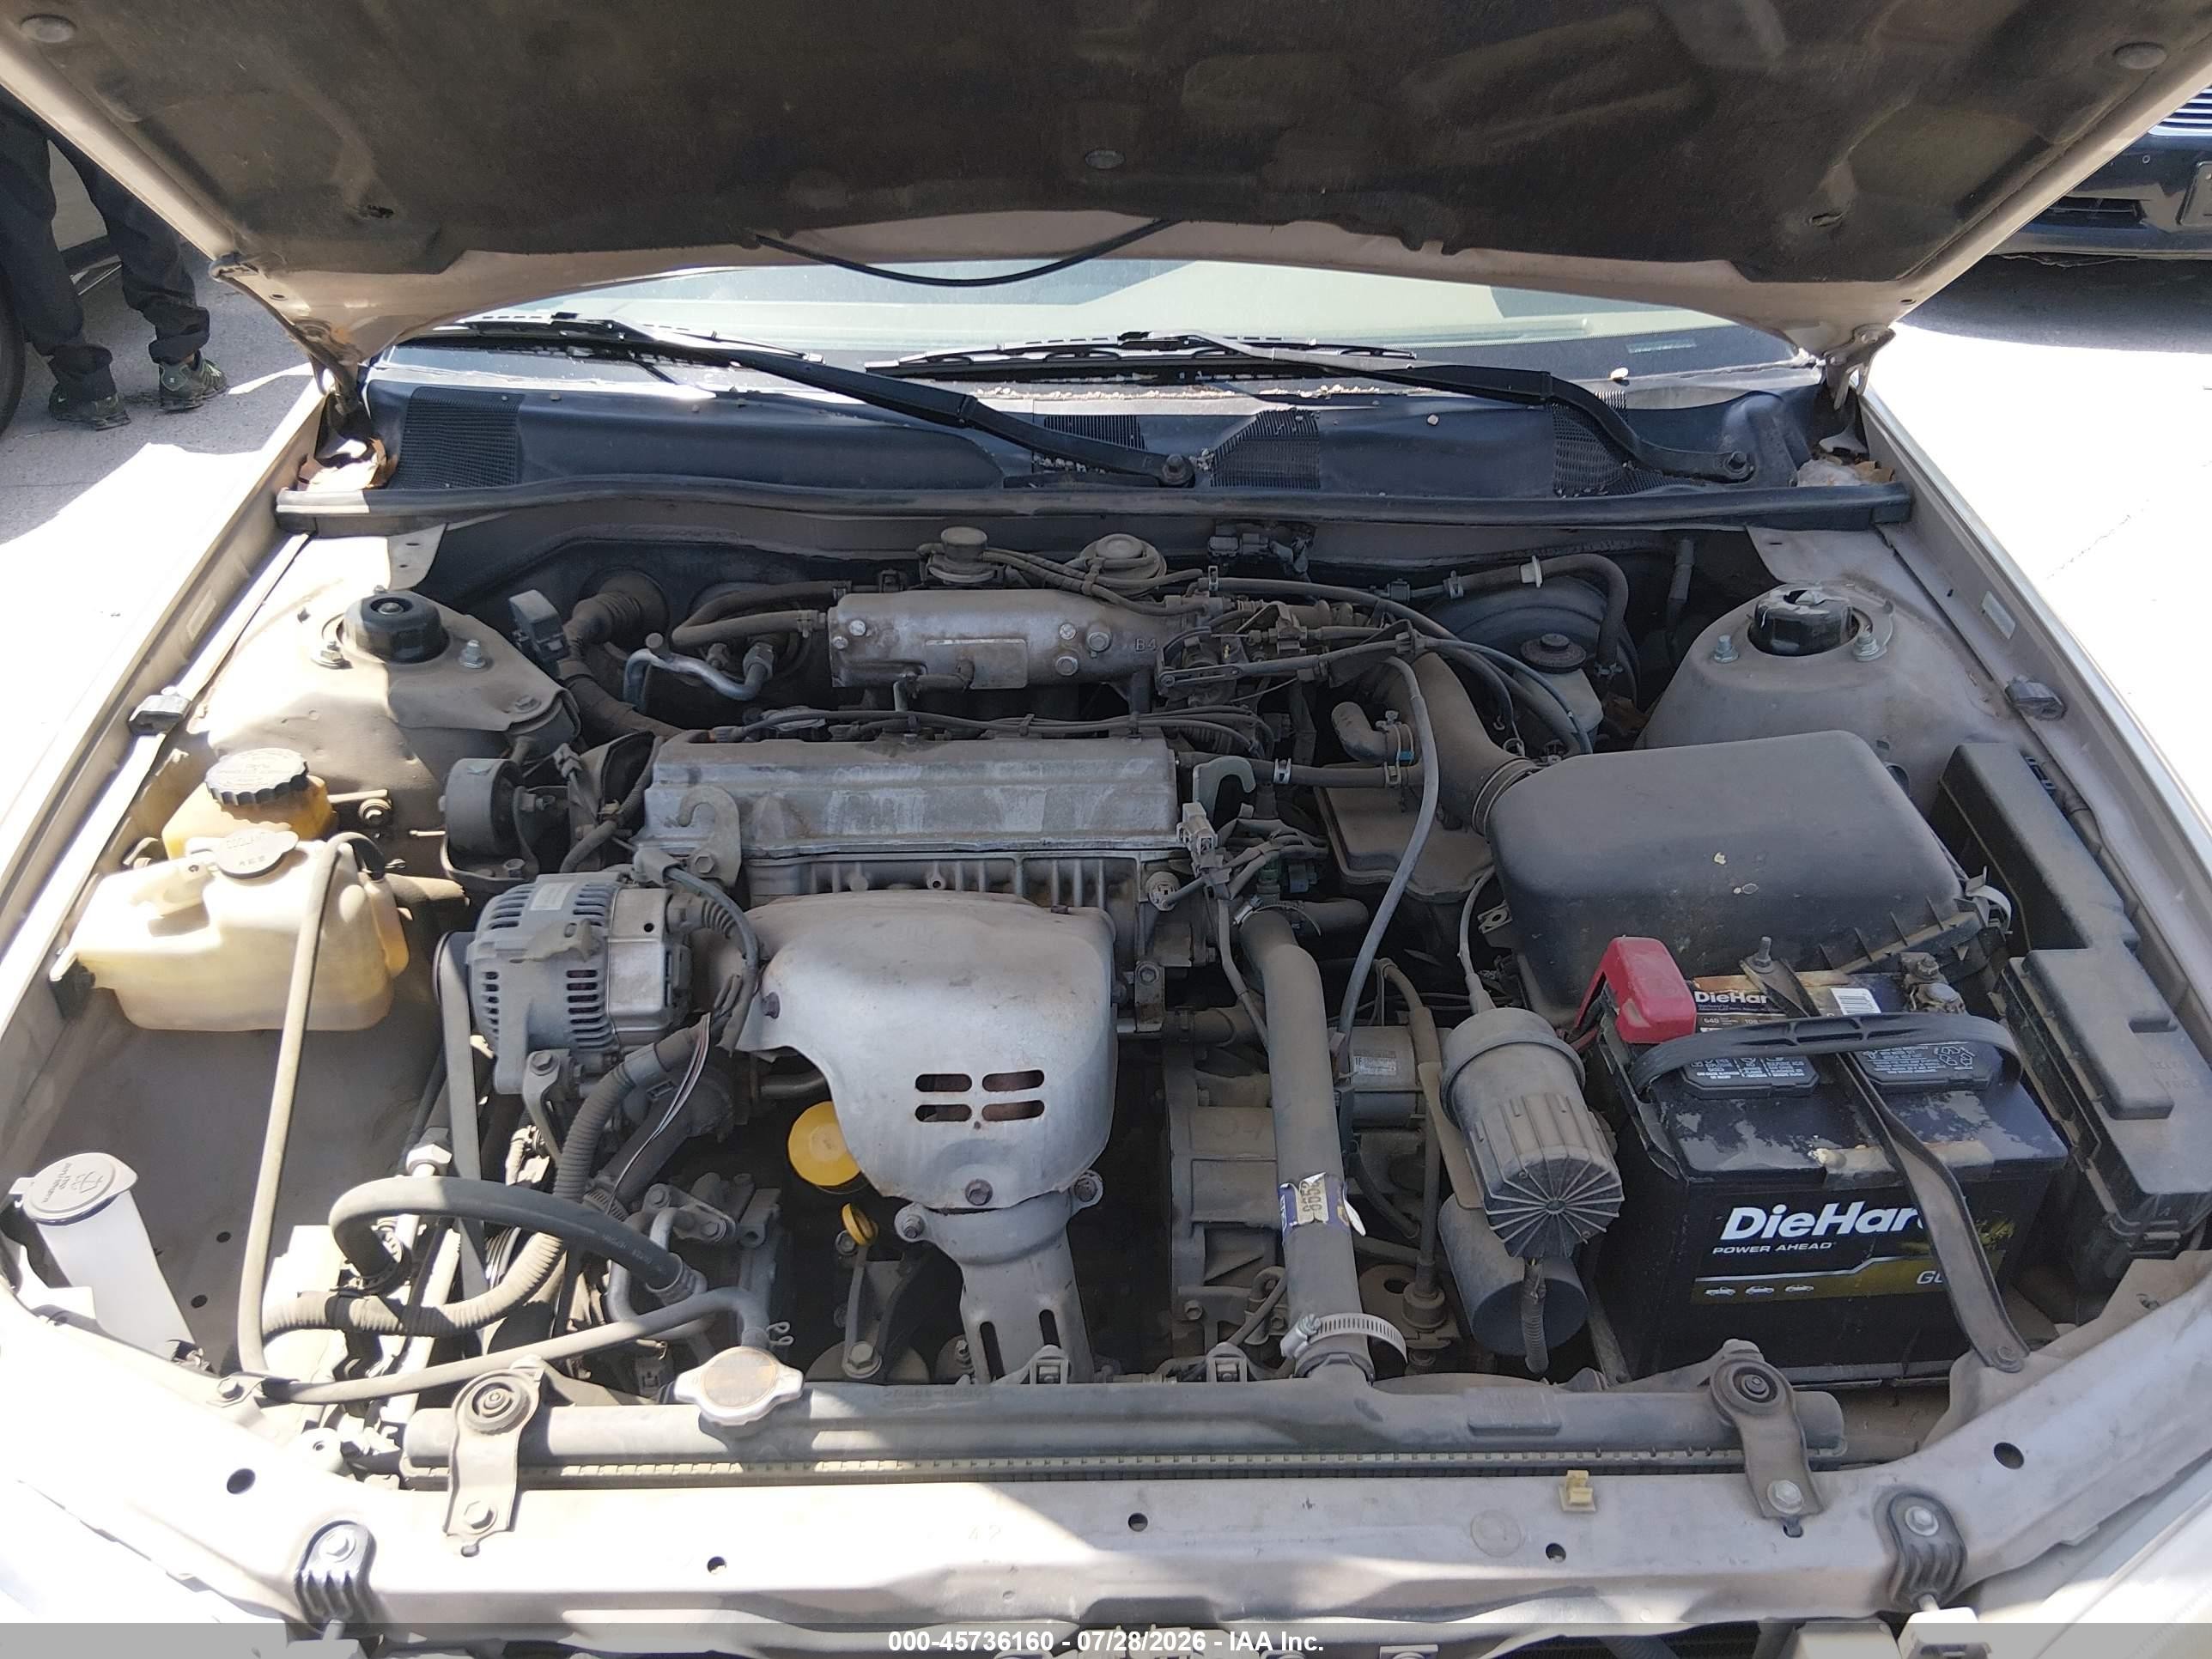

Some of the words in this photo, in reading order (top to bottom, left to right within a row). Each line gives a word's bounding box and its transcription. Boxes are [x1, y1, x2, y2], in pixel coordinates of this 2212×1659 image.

[1134, 638, 1158, 653] B4
[1694, 990, 1768, 1004] DieHar
[1720, 1200, 1923, 1241] DieHar
[1712, 1245, 1771, 1255] POWER
[1775, 1242, 1832, 1252] AHEAD
